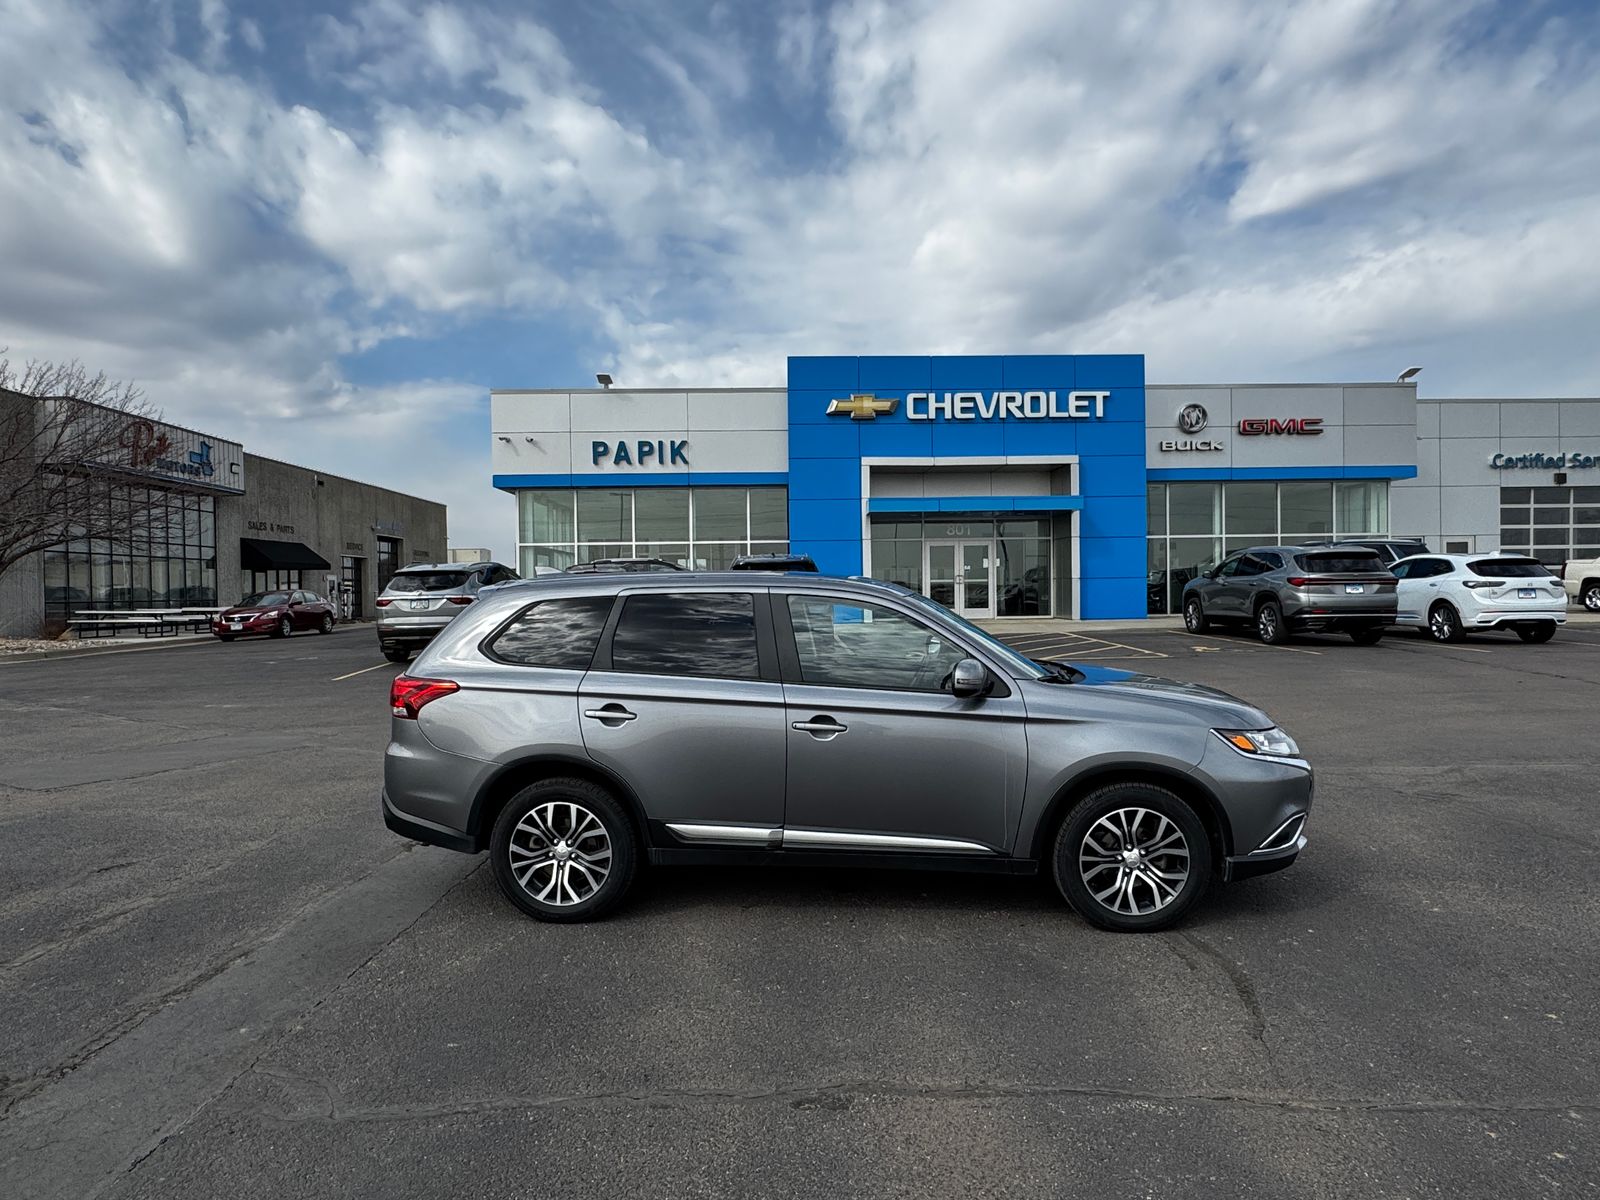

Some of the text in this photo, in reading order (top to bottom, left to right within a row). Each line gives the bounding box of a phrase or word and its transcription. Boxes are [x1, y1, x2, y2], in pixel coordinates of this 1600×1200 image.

[906, 391, 1111, 420] CHEVROLET
[1239, 418, 1324, 436] GMC
[592, 440, 689, 466] PAPIK
[1161, 440, 1224, 452] BUICK
[1491, 452, 1566, 469] Certified
[247, 520, 295, 535] SALES & PARTS
[946, 523, 971, 536] 801
